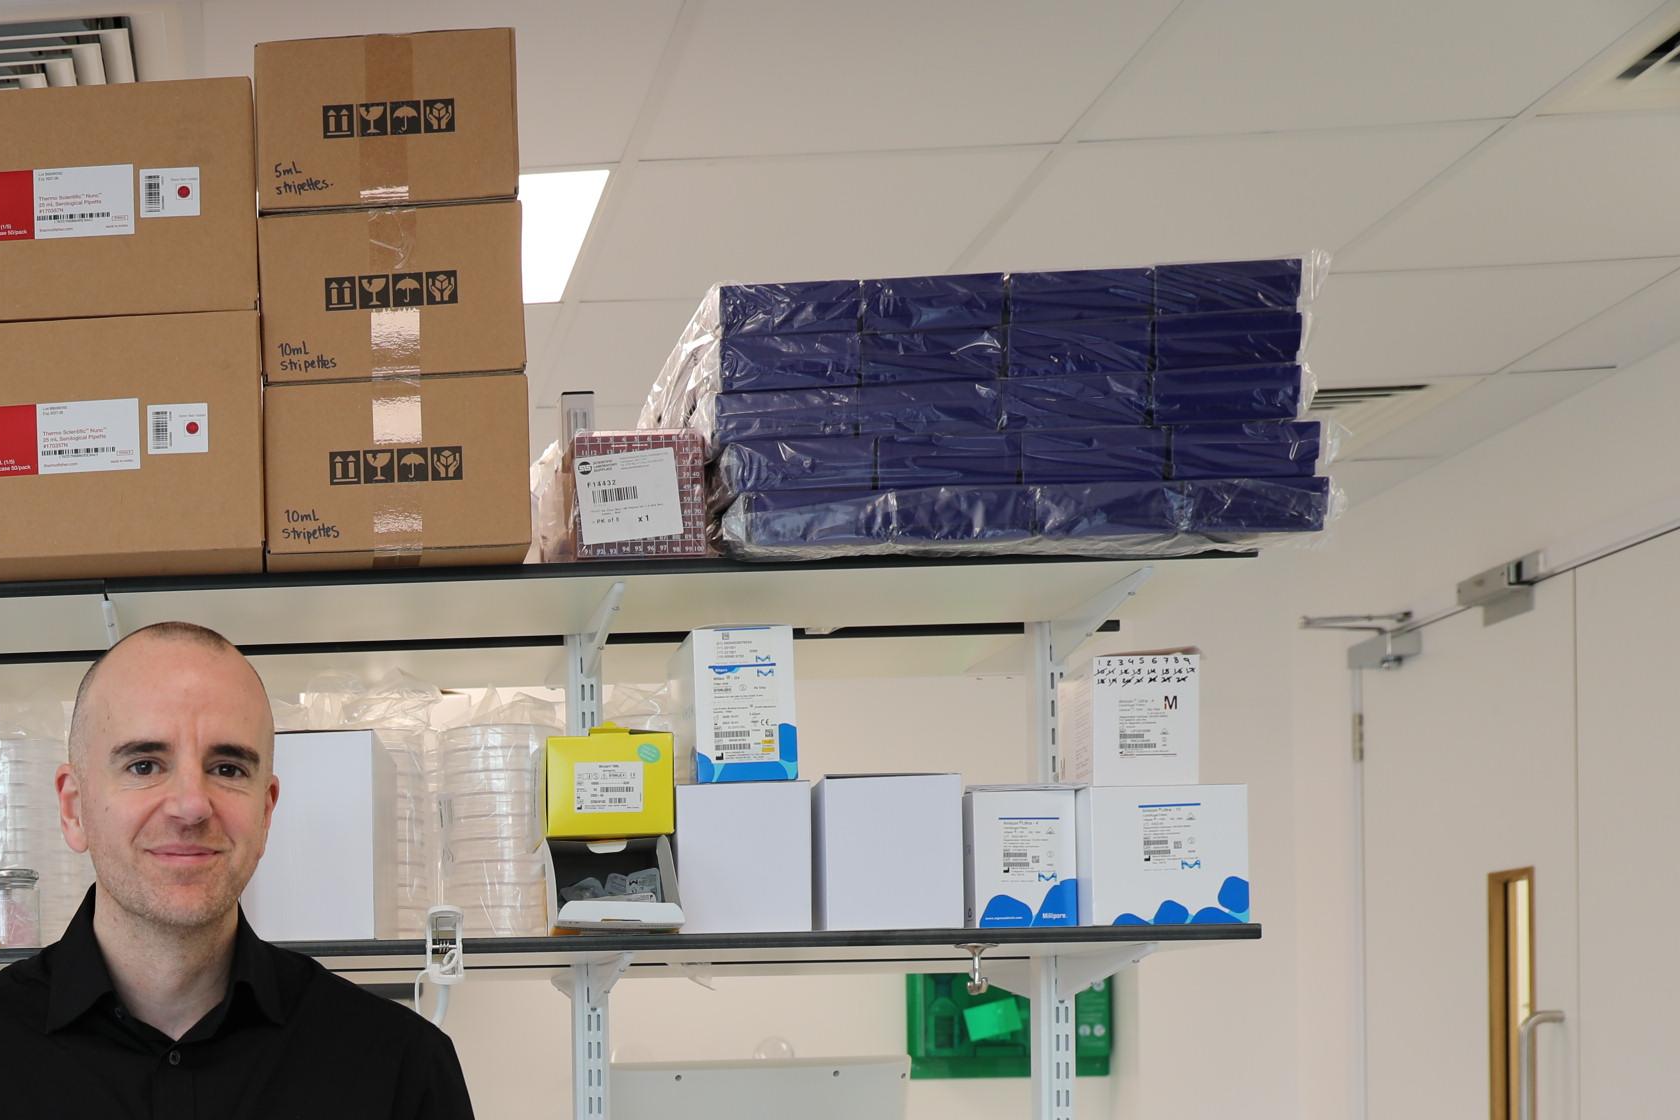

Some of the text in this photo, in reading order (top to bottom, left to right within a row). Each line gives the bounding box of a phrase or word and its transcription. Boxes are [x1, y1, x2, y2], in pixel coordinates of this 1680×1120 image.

[278, 341, 309, 357] 10mL
[284, 509, 319, 523] 10mL
[282, 524, 340, 544] stripettes
[1164, 695, 1178, 710] M
